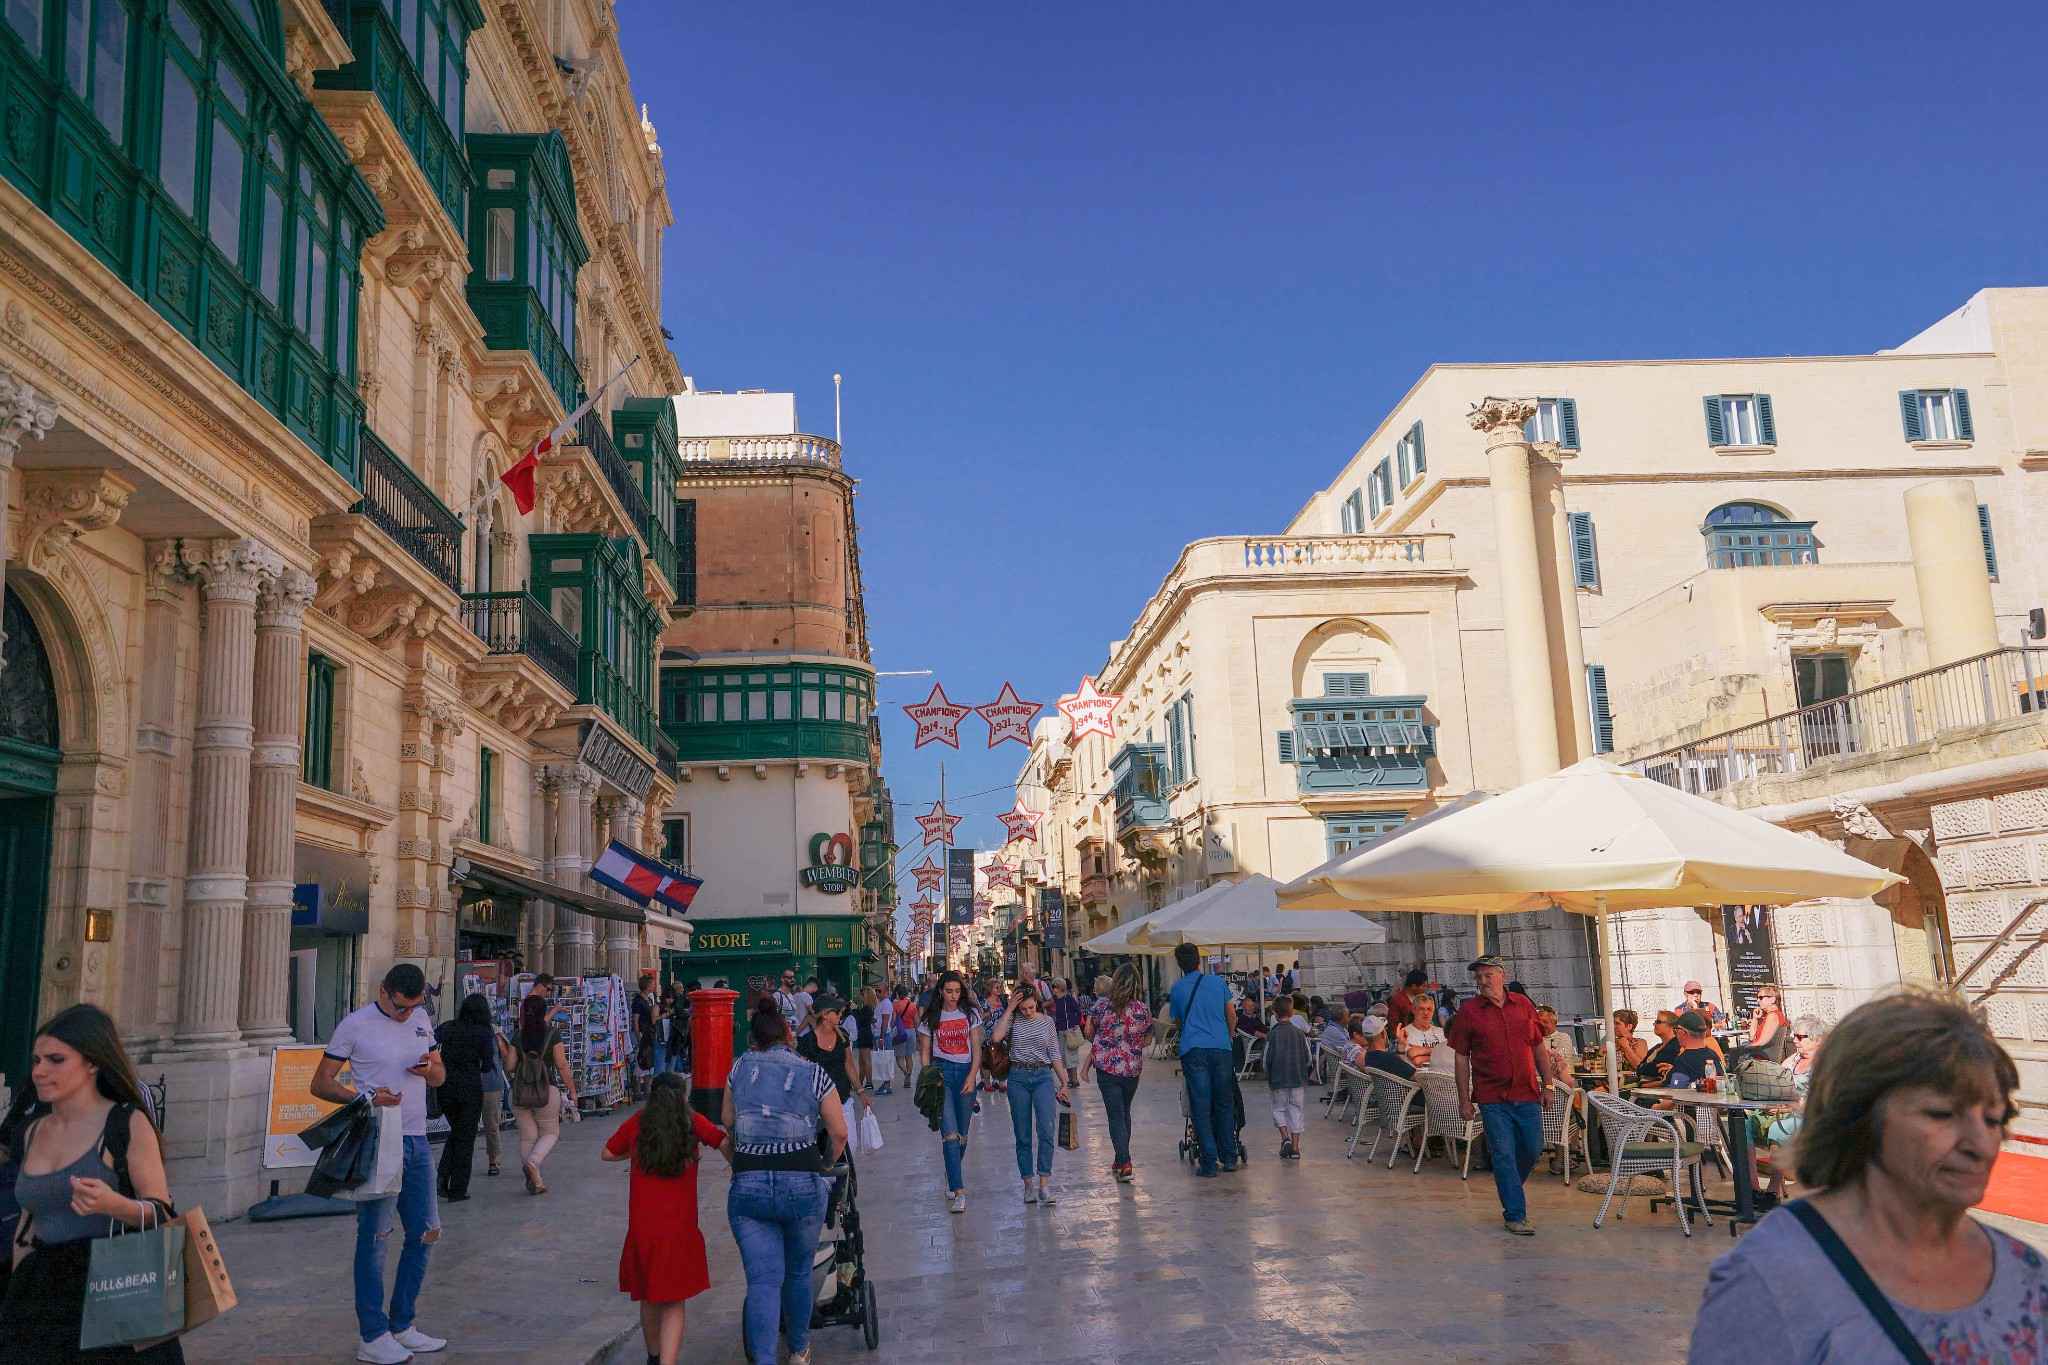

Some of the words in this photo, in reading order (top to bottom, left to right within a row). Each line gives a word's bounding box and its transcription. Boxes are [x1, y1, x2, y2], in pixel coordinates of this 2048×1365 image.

[914, 707, 961, 719] CHAMPIONS
[985, 705, 1032, 718] CHAMPIONS
[1066, 700, 1113, 713] CHAMPIONS
[919, 720, 955, 738] 1914-15
[991, 718, 1027, 736] 1931-32
[922, 817, 955, 825] CHAMPONS
[806, 866, 858, 887] WEMBLEY
[823, 883, 845, 892] STORE
[699, 932, 751, 949] STORE
[89, 1271, 158, 1294] PULL&BEAR
